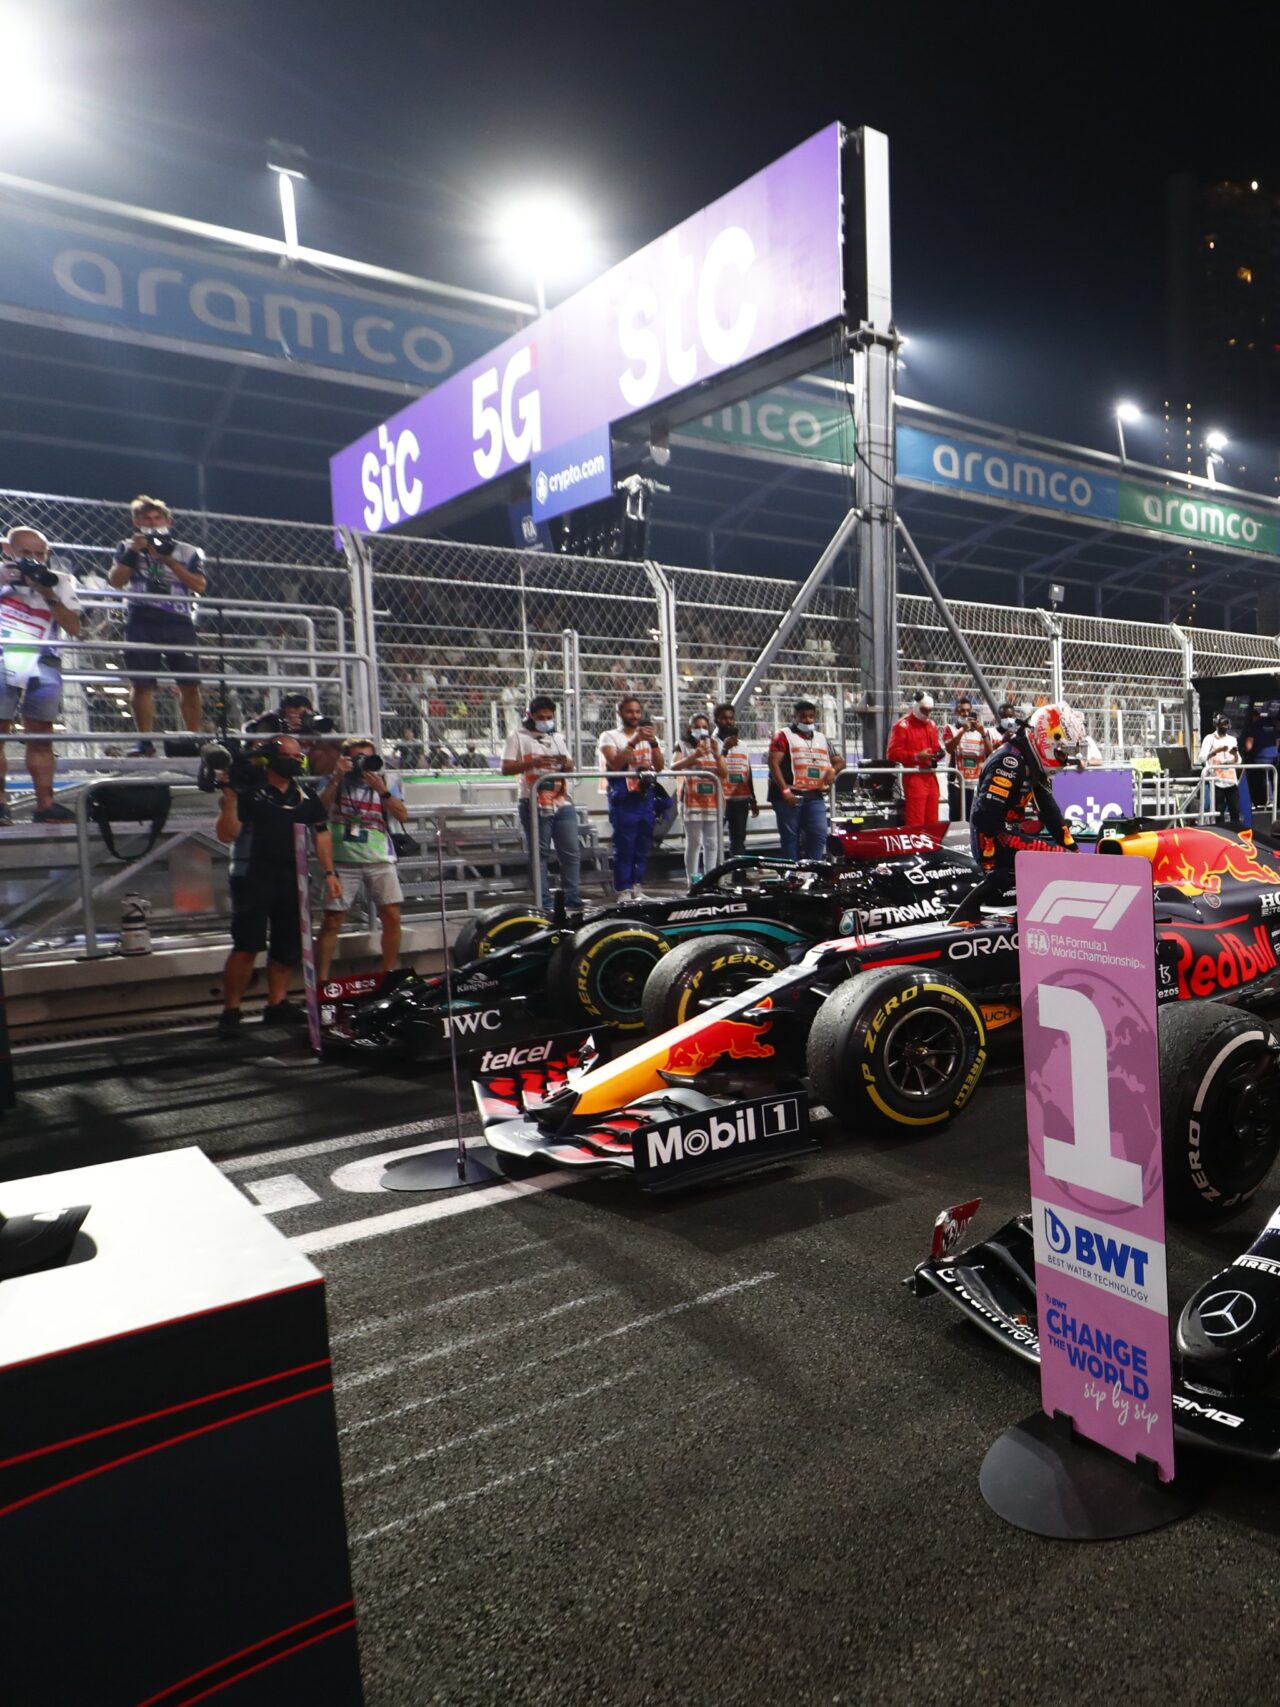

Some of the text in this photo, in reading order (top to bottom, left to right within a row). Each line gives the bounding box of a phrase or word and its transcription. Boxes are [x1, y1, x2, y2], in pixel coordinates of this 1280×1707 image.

[52, 249, 454, 374] aramco
[618, 226, 758, 407] stc
[471, 346, 541, 479] 5G
[704, 399, 822, 447] mco
[361, 425, 422, 534] stc
[549, 455, 605, 492] crypto.com
[932, 443, 1092, 507] aramco
[1143, 495, 1260, 543] aramco
[881, 834, 934, 852] INEOS
[695, 902, 748, 918] AMG
[857, 896, 947, 928] PETRONAS
[1025, 880, 1143, 931] F1
[711, 953, 775, 973] ZERO
[948, 933, 1019, 961] ORAC
[1051, 935, 1108, 952] FIA Formula 1
[1051, 947, 1077, 960] World
[456, 976, 499, 994] Kingspan
[577, 960, 600, 1018] ZERO
[1157, 986, 1179, 999] ezos
[442, 1009, 502, 1039] IWC
[864, 985, 918, 1054] ZERO
[984, 1011, 1012, 1022] UCH
[480, 1040, 553, 1073] telcel
[1038, 984, 1144, 1208] 1
[647, 1104, 787, 1168] Mobil 1
[1188, 1119, 1222, 1203] ZERO
[1047, 1254, 1149, 1303] BEST WATER TECHNOLOGY
[1075, 1225, 1149, 1287] BWT
[1046, 1308, 1148, 1377] CHANGE
[1047, 1334, 1150, 1402] THE WORLD
[1083, 1380, 1159, 1434] sip by sip
